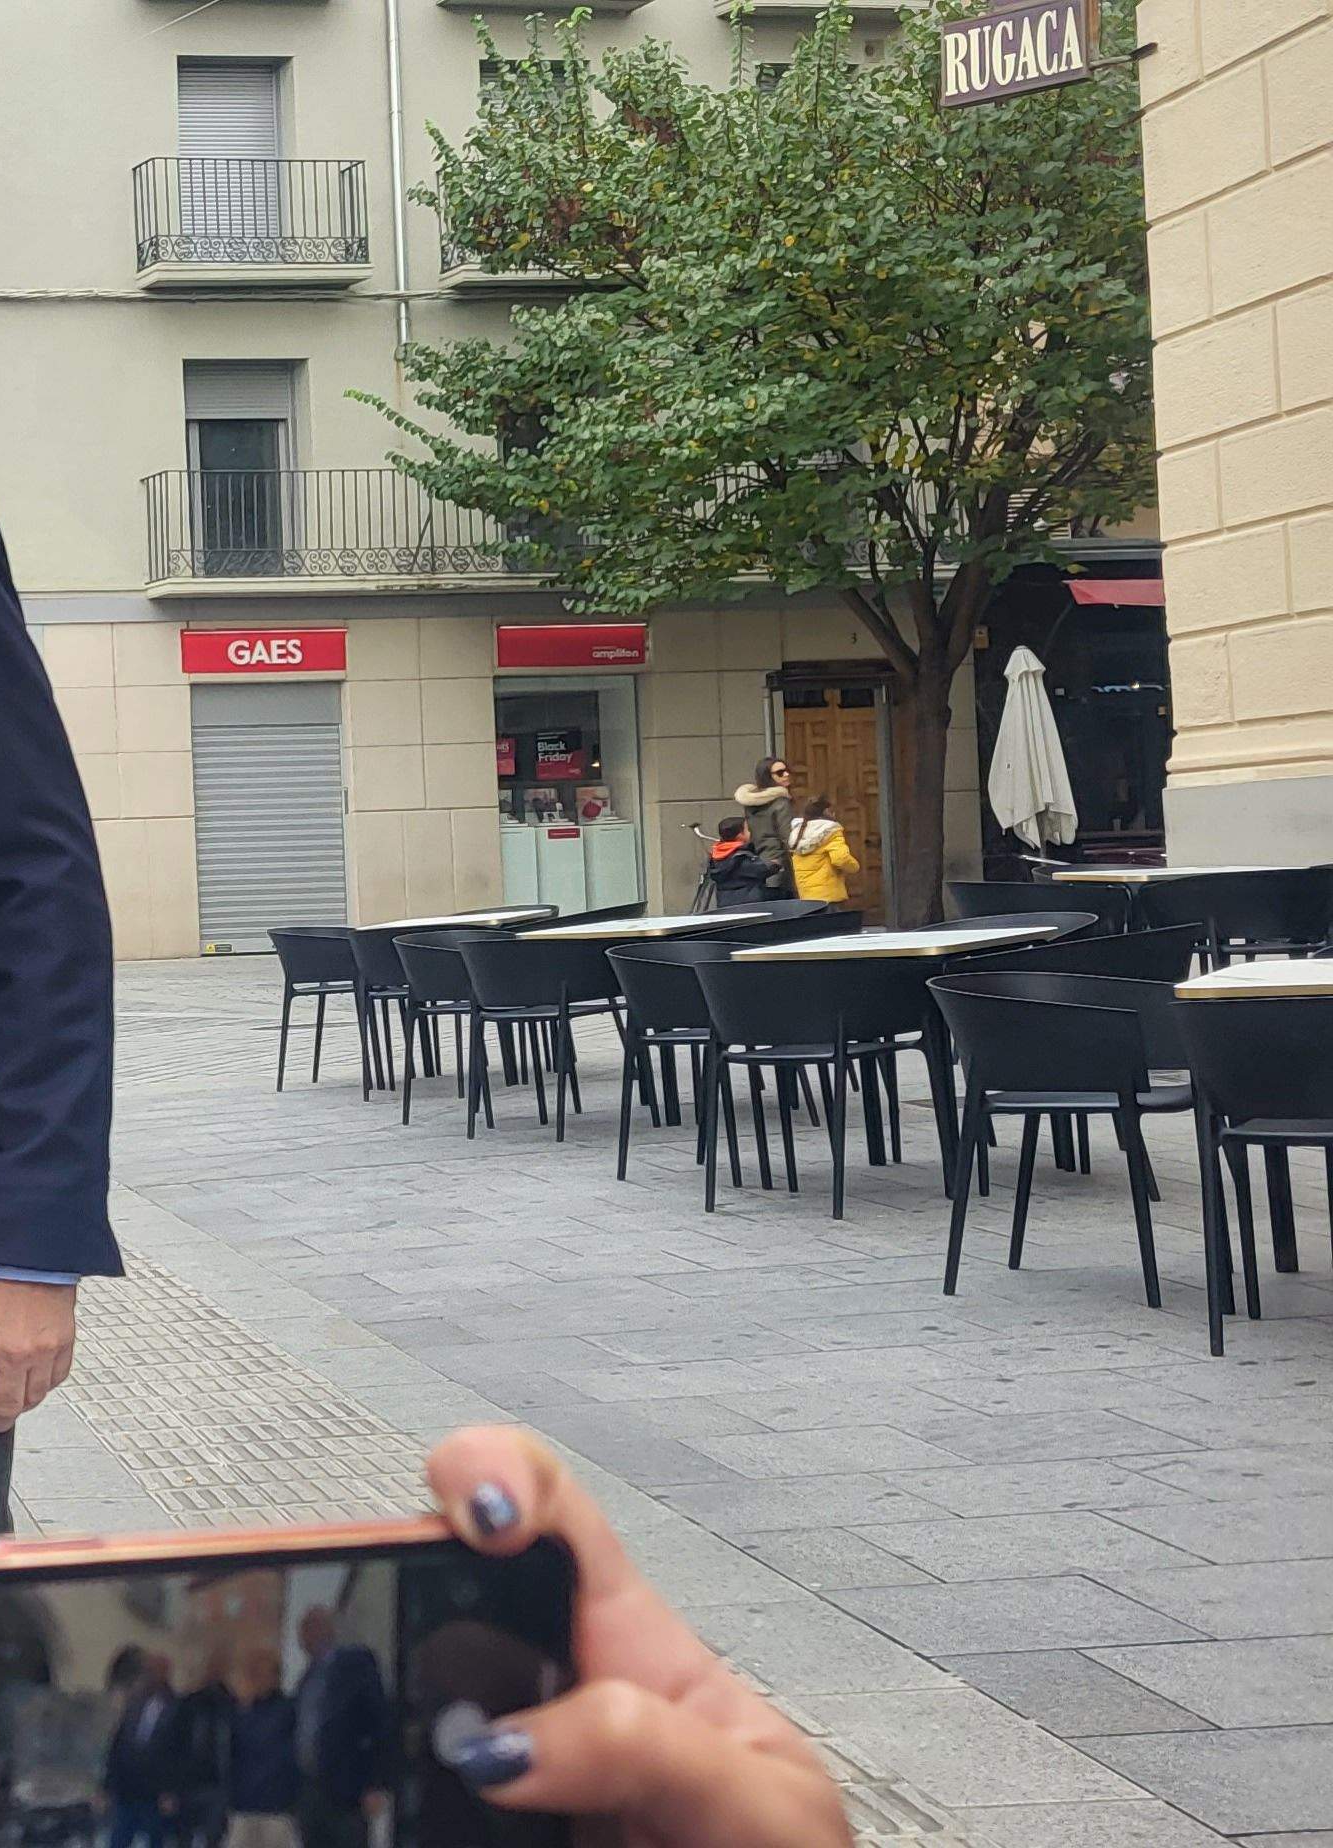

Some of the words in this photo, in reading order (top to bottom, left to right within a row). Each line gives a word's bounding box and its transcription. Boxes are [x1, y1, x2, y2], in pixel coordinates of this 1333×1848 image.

[944, 6, 1083, 96] RUGACA
[227, 639, 303, 665] GAES
[592, 648, 639, 660] amplifon
[537, 741, 566, 751] Black
[538, 752, 572, 763] Friday
